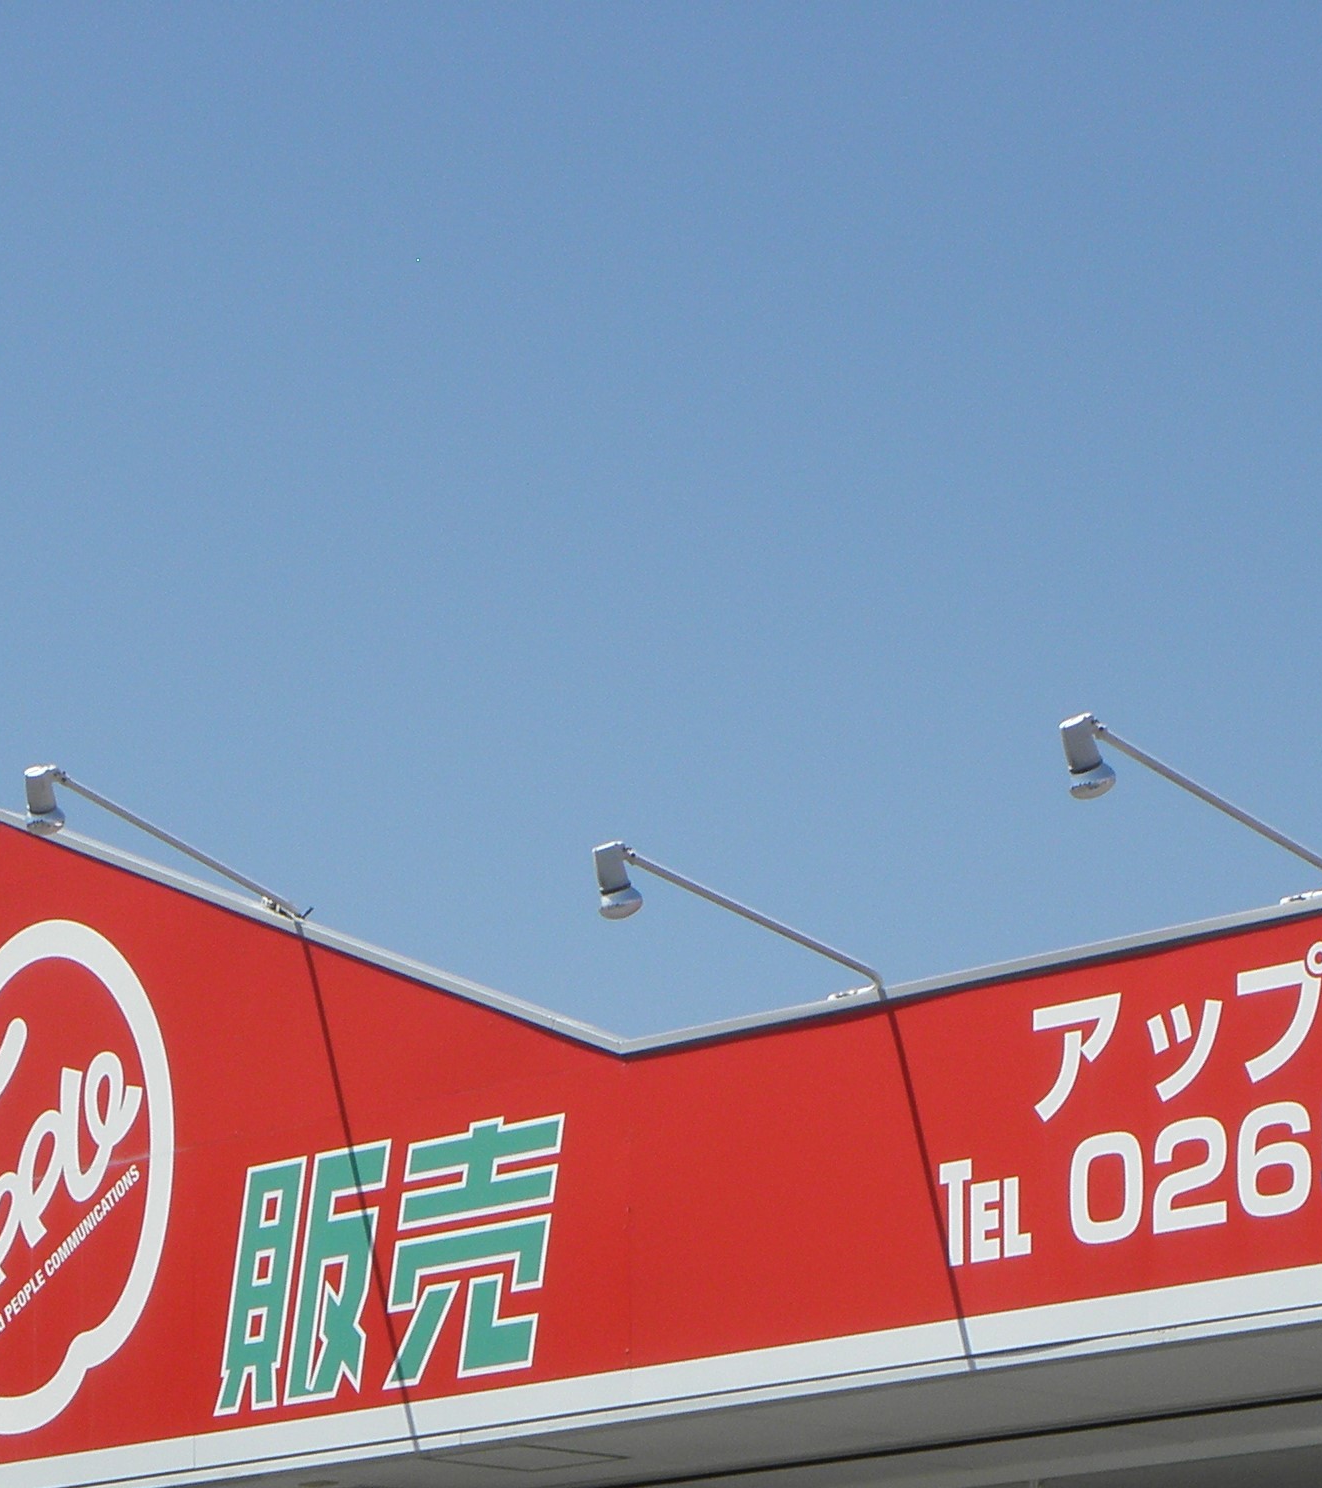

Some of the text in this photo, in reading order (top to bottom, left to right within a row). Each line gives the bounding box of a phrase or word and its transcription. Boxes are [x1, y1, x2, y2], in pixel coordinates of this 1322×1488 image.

[4, 1269, 46, 1322] PEOPLE
[44, 1164, 141, 1277] COMMUNICATIONS
[214, 1112, 565, 1416] 販売
[939, 1158, 1032, 1267] TEL
